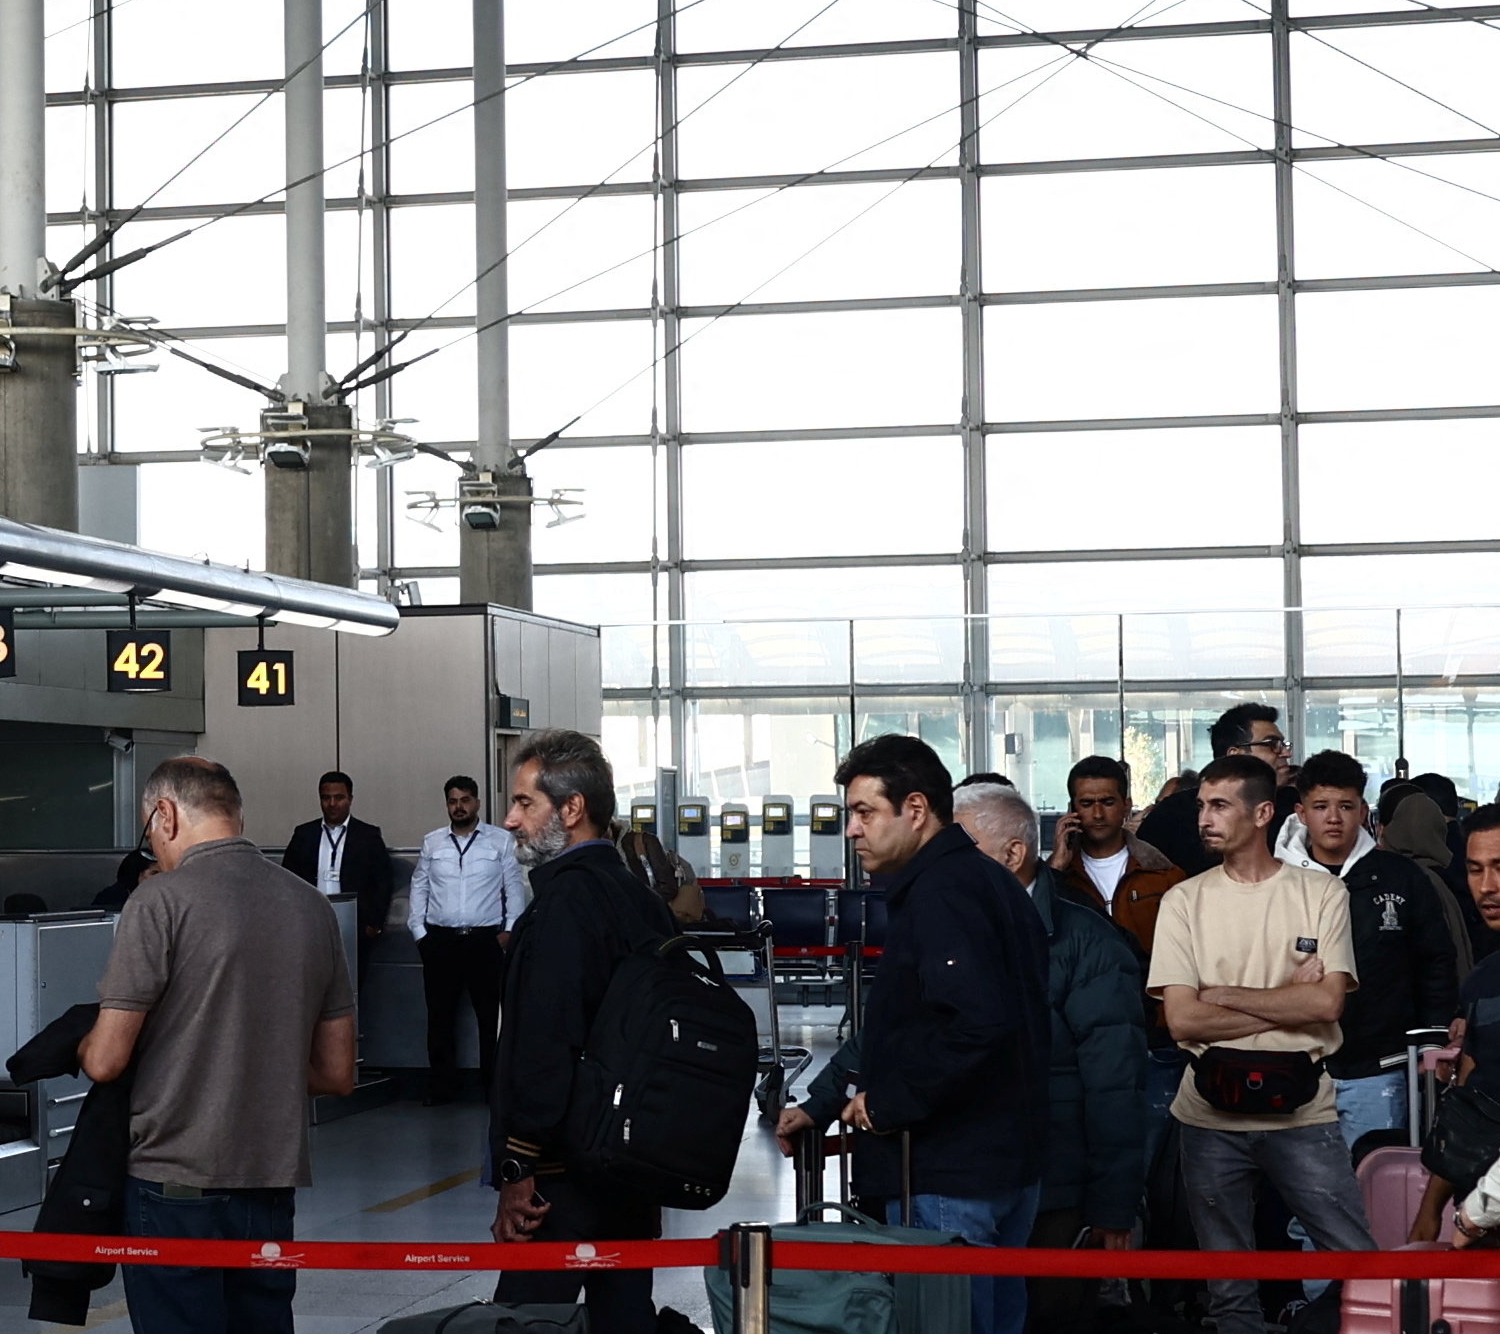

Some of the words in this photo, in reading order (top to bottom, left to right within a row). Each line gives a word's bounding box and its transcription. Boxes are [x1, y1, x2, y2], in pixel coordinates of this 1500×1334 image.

[113, 642, 166, 681] 42
[246, 661, 287, 696] 41
[94, 1244, 126, 1257] Airport
[126, 1246, 159, 1257] Service
[404, 1253, 436, 1265] Airport
[436, 1253, 471, 1264] Service
